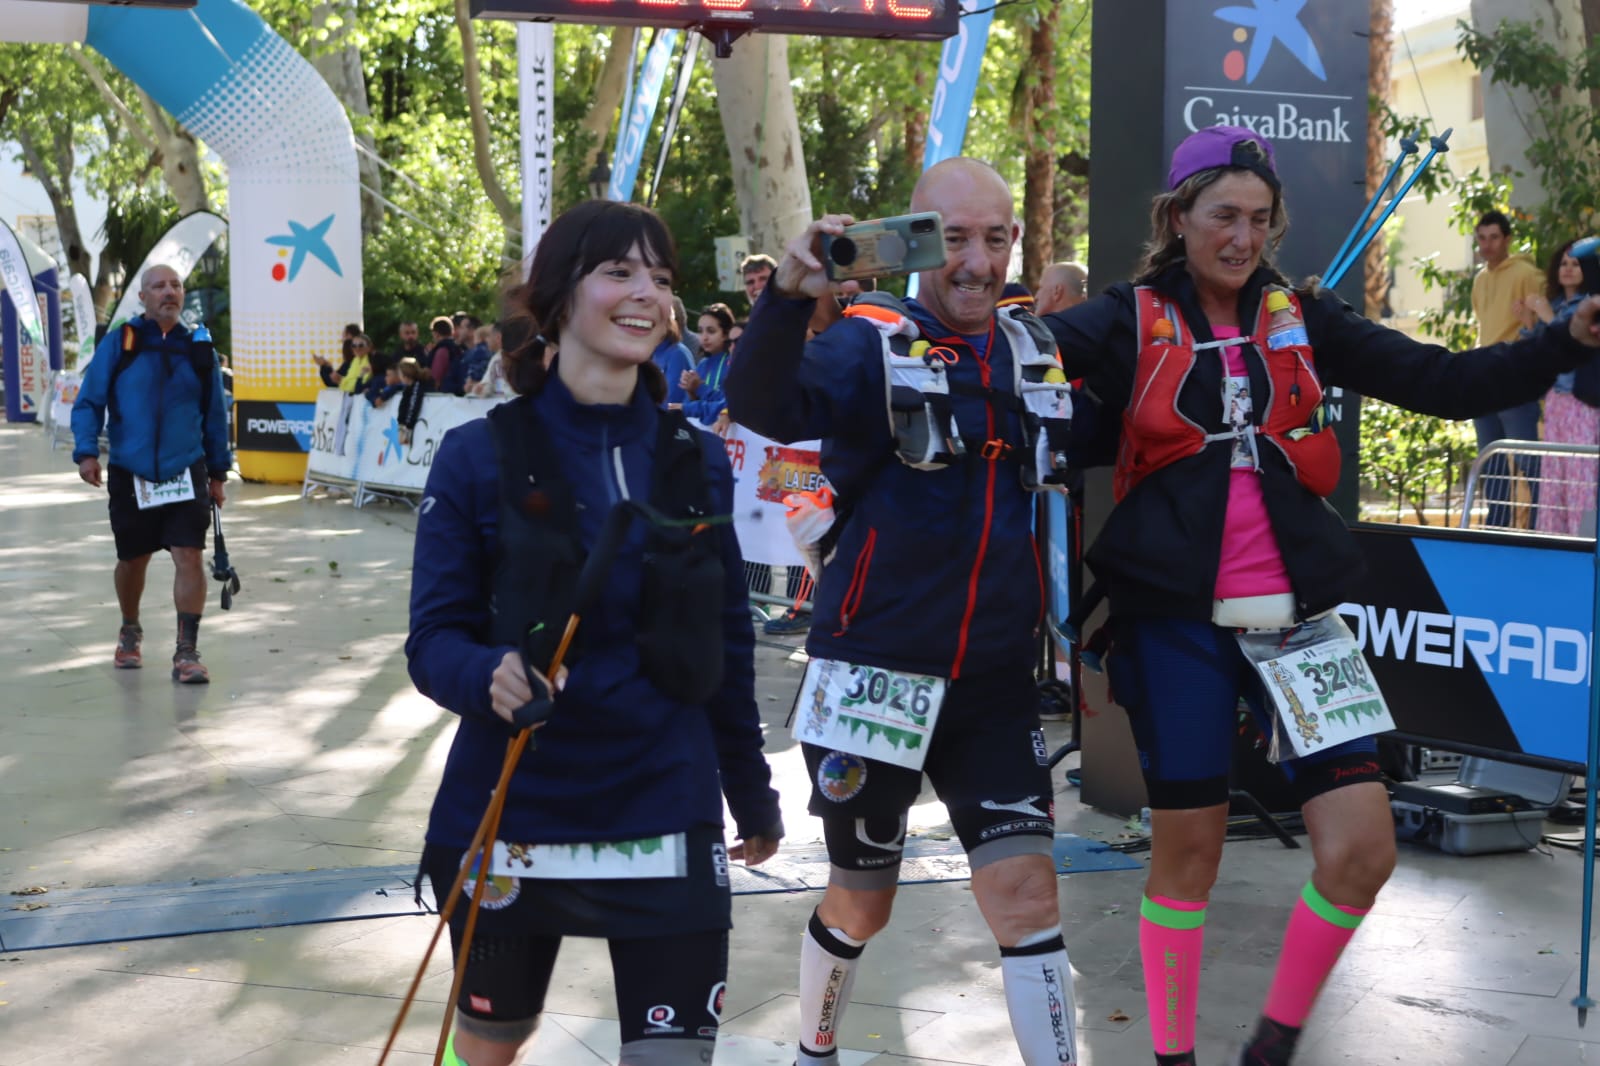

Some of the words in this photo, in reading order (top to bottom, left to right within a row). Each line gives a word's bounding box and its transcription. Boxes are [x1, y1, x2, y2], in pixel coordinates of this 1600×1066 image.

[1184, 96, 1352, 143] CaixaBank
[1336, 602, 1593, 685] OWERAD
[845, 666, 933, 716] 3026
[1304, 656, 1368, 695] 3209
